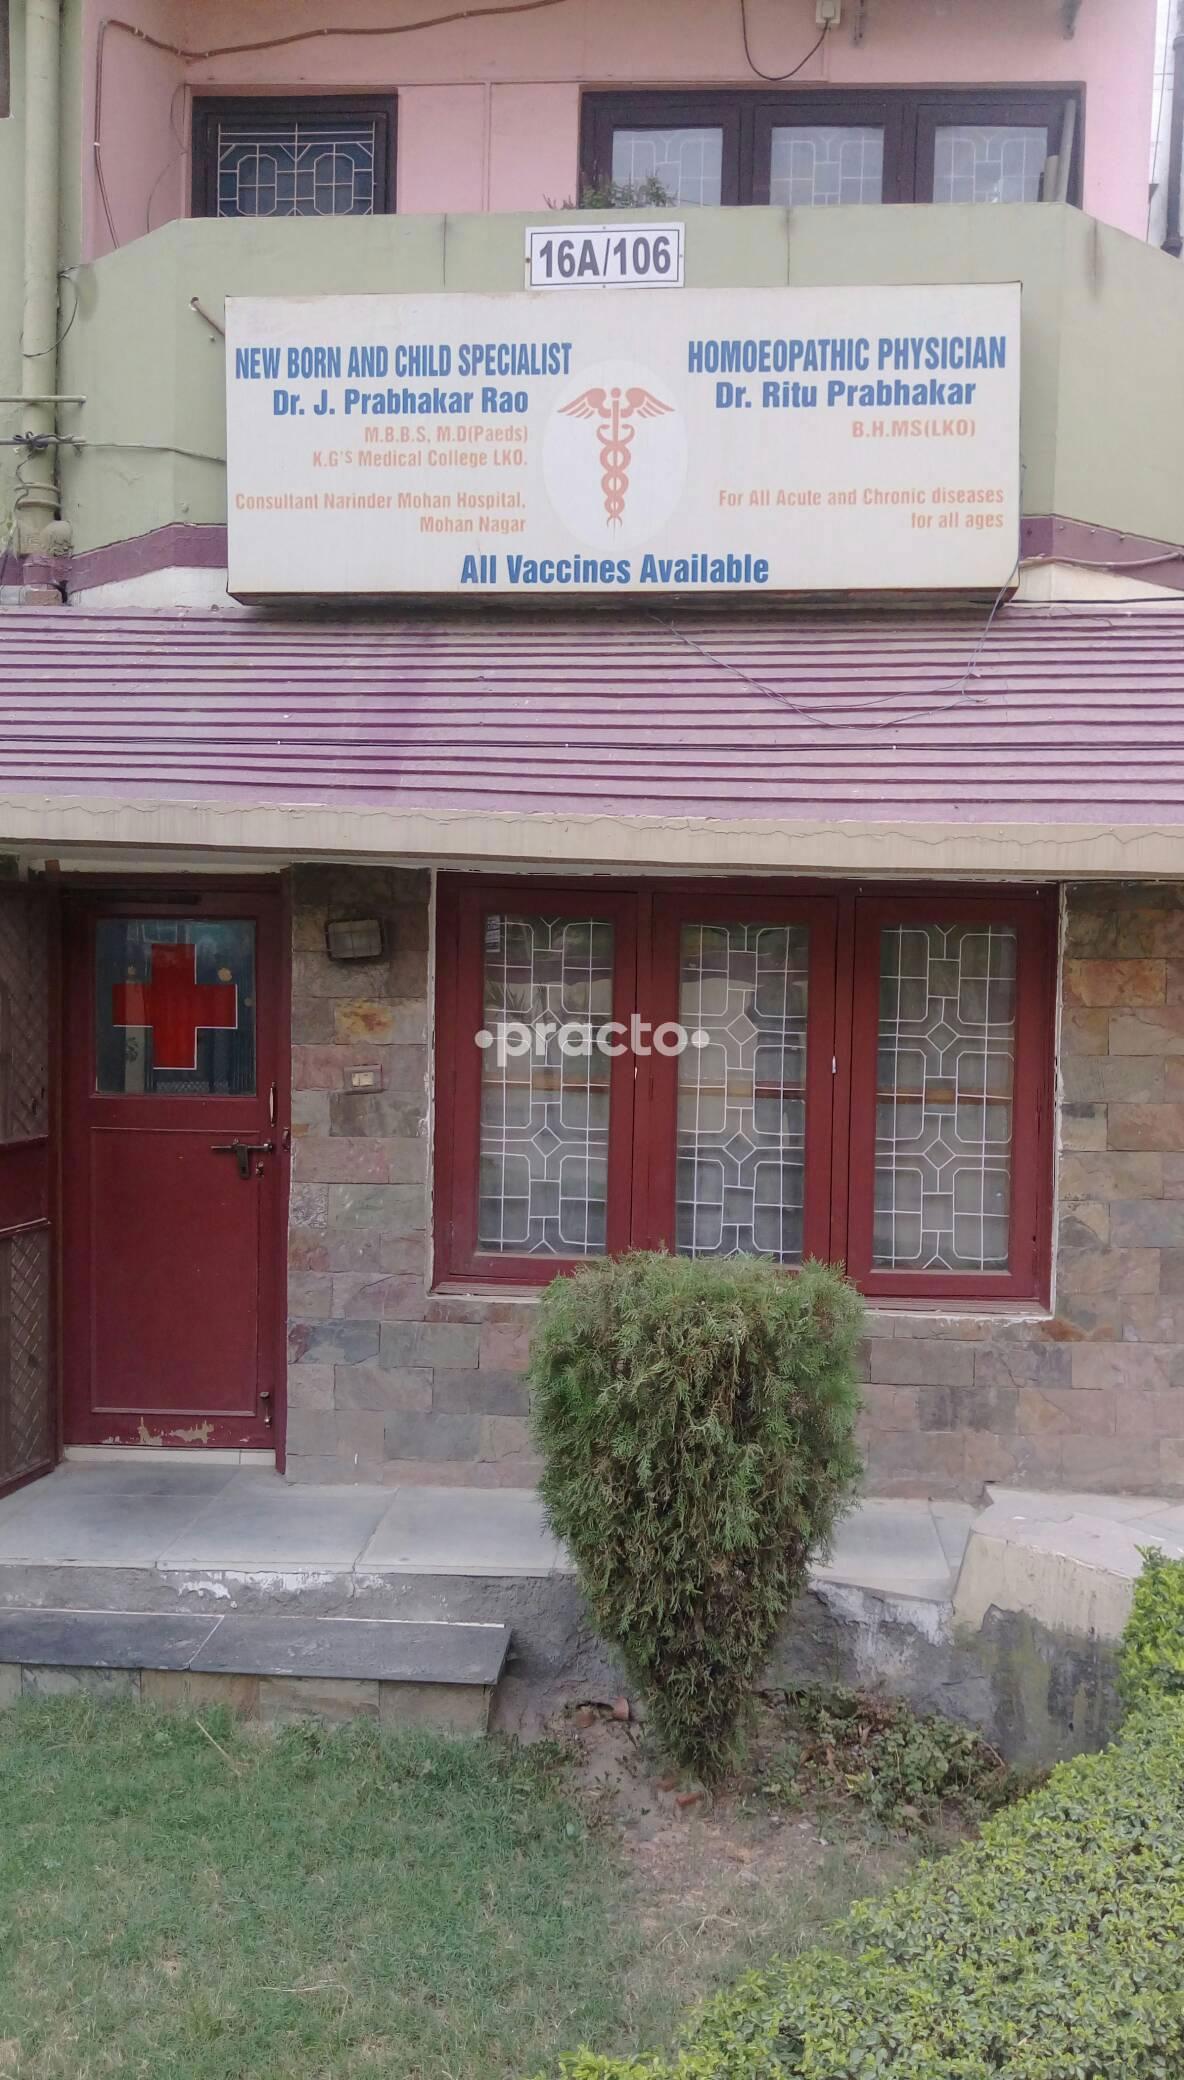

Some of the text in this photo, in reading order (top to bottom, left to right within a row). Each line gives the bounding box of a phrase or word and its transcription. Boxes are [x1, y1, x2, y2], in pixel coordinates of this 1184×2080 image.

[539, 235, 671, 278] 16A/106
[235, 342, 573, 380] NEW BORN AND CHILD SPECIALIST
[687, 335, 1007, 374] HOMOEOPATHIC PHYSICIAN
[273, 386, 529, 416] Dr. J. Prabhakar Rao
[715, 378, 977, 409] Dr. Ritu Prabhakar
[436, 424, 528, 444] M.D(Paeds)
[357, 449, 422, 467] Medical
[427, 449, 488, 469] College
[493, 448, 528, 467] LKO.
[235, 493, 319, 510] Consultant
[323, 492, 393, 510] Narinder
[397, 491, 452, 509] Mohan
[719, 487, 1004, 507] For All Acute and Chronic diseases
[419, 515, 526, 535] Mohan Nagar
[911, 511, 1004, 531] for all ages
[460, 553, 769, 585] All Vaccines Available
